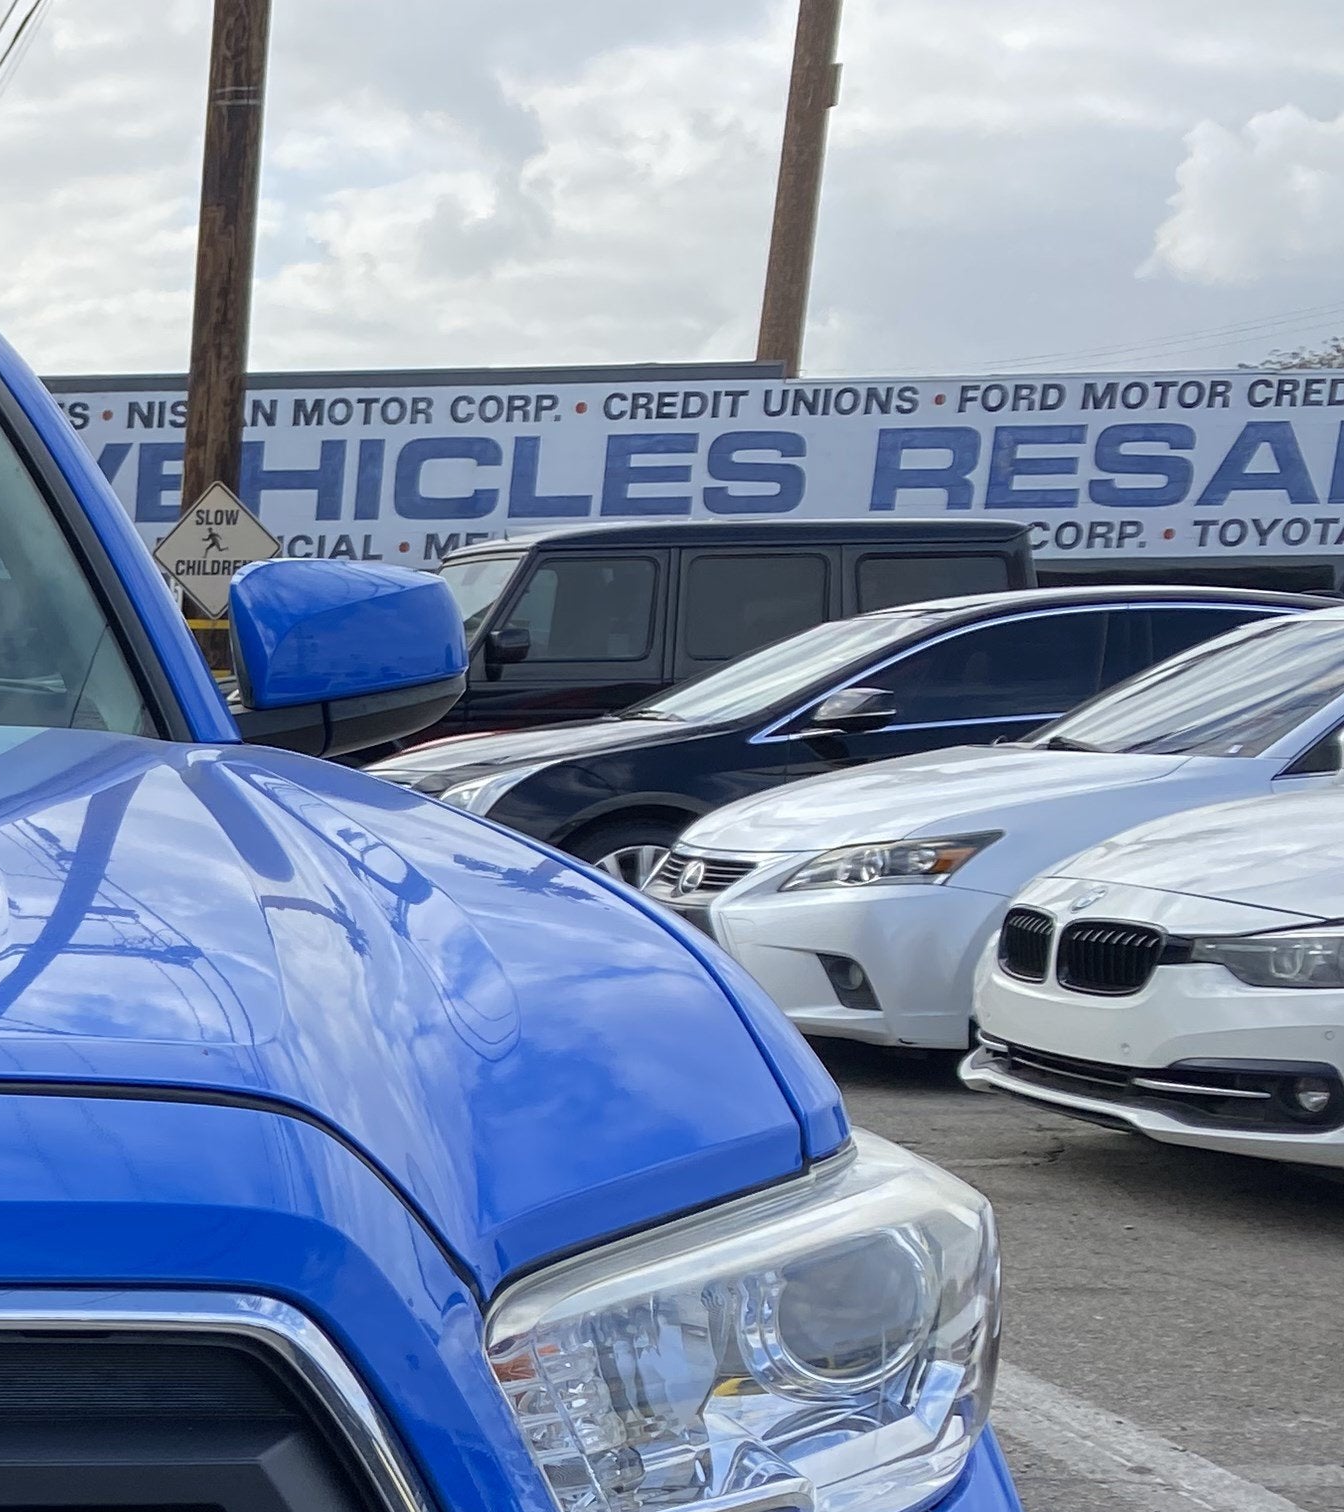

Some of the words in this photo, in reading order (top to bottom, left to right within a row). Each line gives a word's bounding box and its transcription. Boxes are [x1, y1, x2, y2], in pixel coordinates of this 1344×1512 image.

[127, 399, 278, 429] NISN
[292, 396, 433, 427] MOTOR
[450, 394, 561, 424] CORP.
[603, 389, 750, 421] CREDIT
[763, 385, 920, 417] UNIONS
[957, 383, 1068, 413] FORD
[1079, 380, 1233, 410] MOTOR
[869, 420, 1344, 512] RESA
[195, 508, 240, 526] SLOW
[1028, 520, 1146, 550] CORP.
